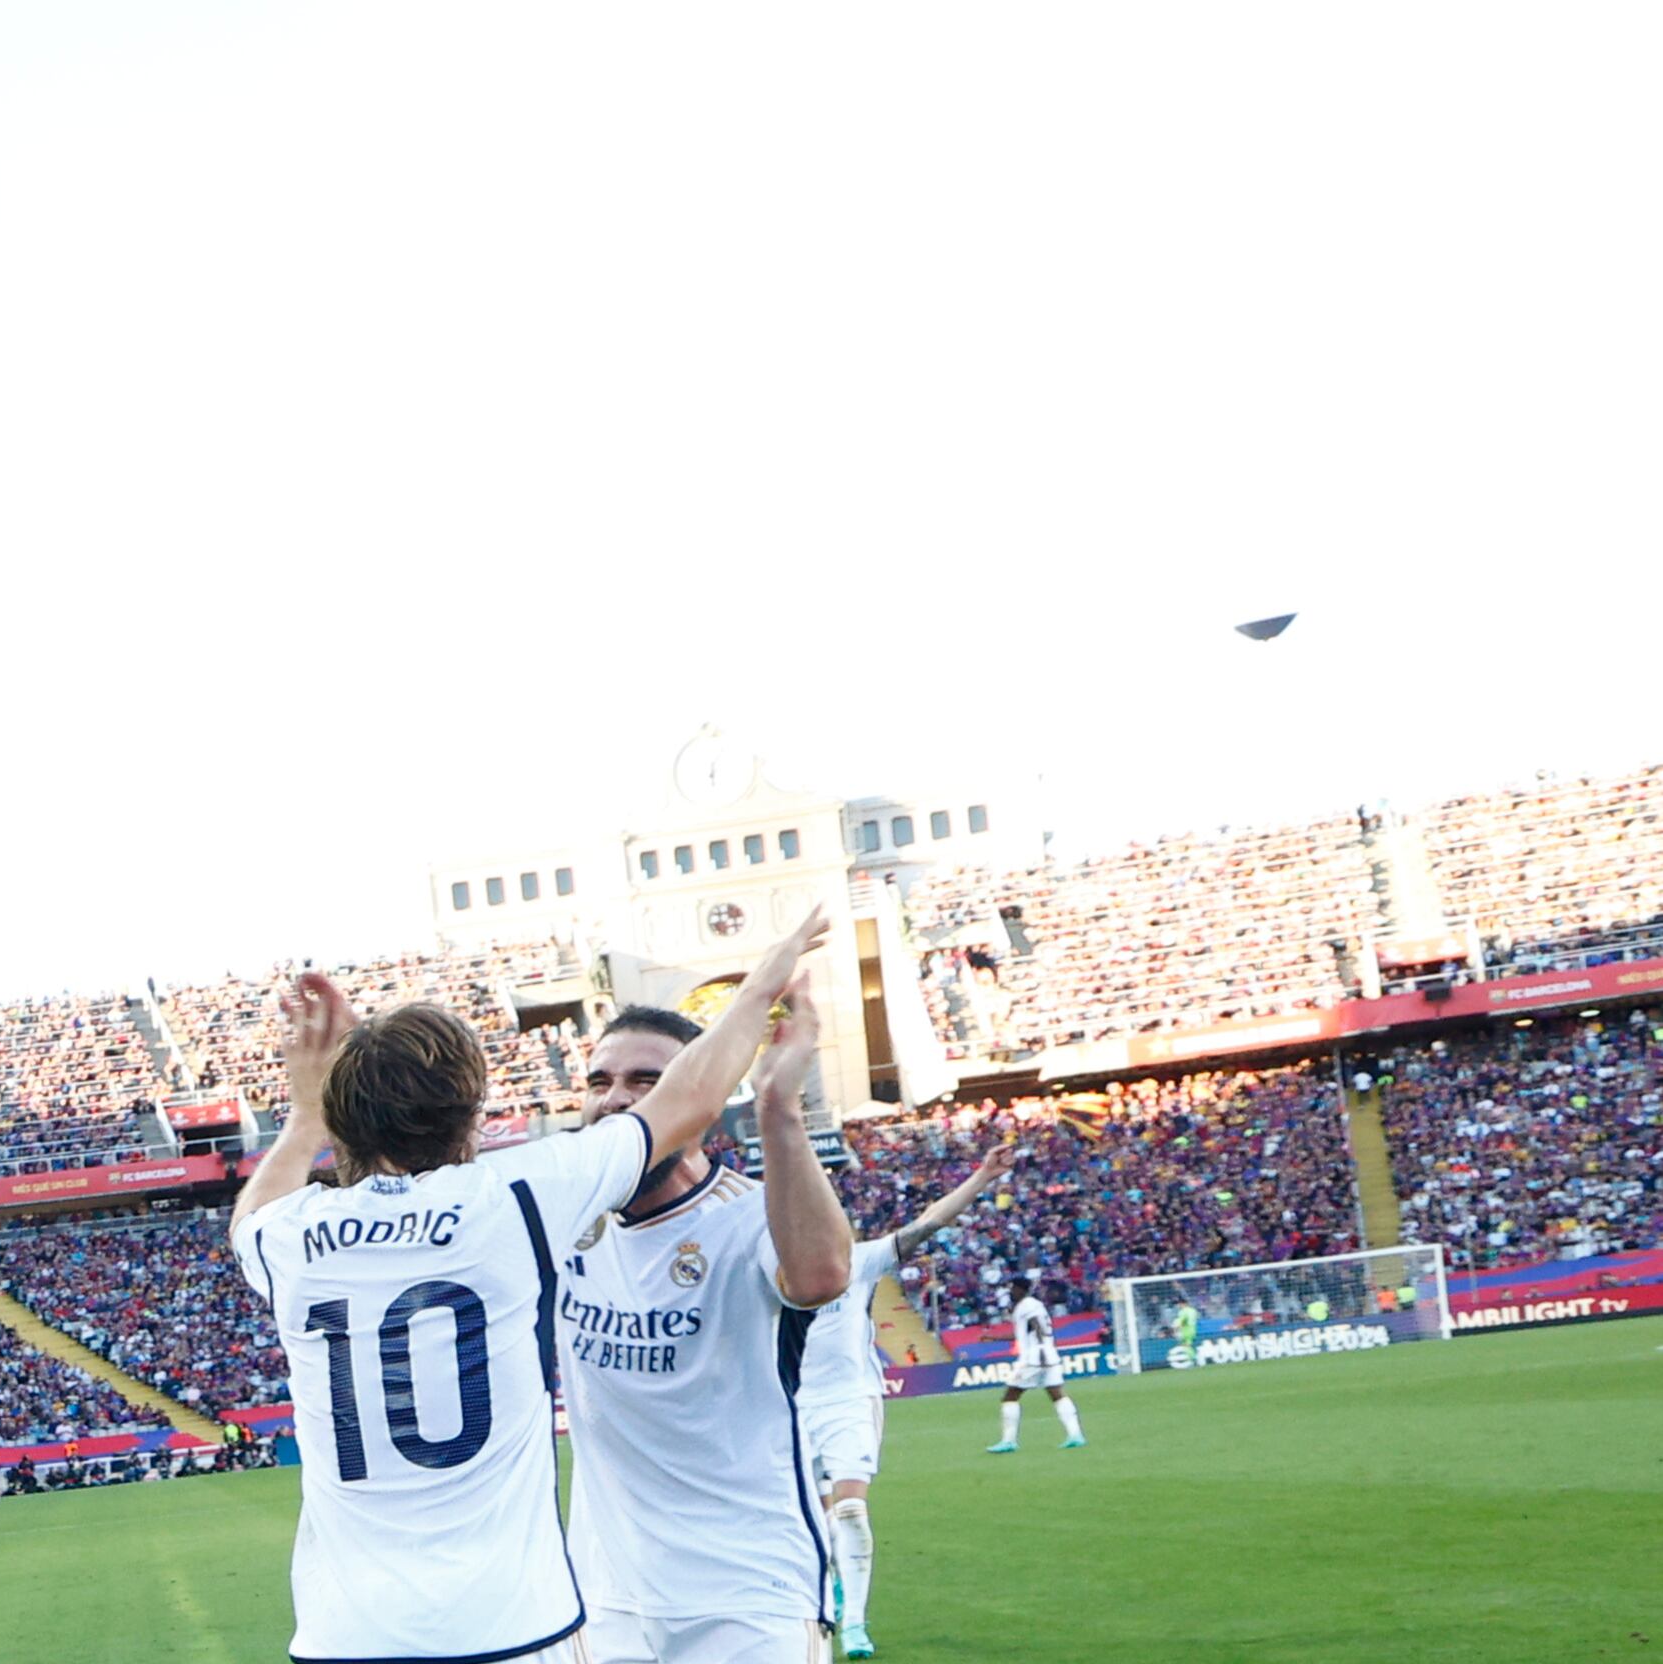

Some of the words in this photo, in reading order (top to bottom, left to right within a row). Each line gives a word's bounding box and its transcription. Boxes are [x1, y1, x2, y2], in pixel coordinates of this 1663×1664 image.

[303, 1204, 463, 1263] MODRIĆ
[304, 1280, 492, 1482] 10
[598, 1341, 676, 1373] BETTER
